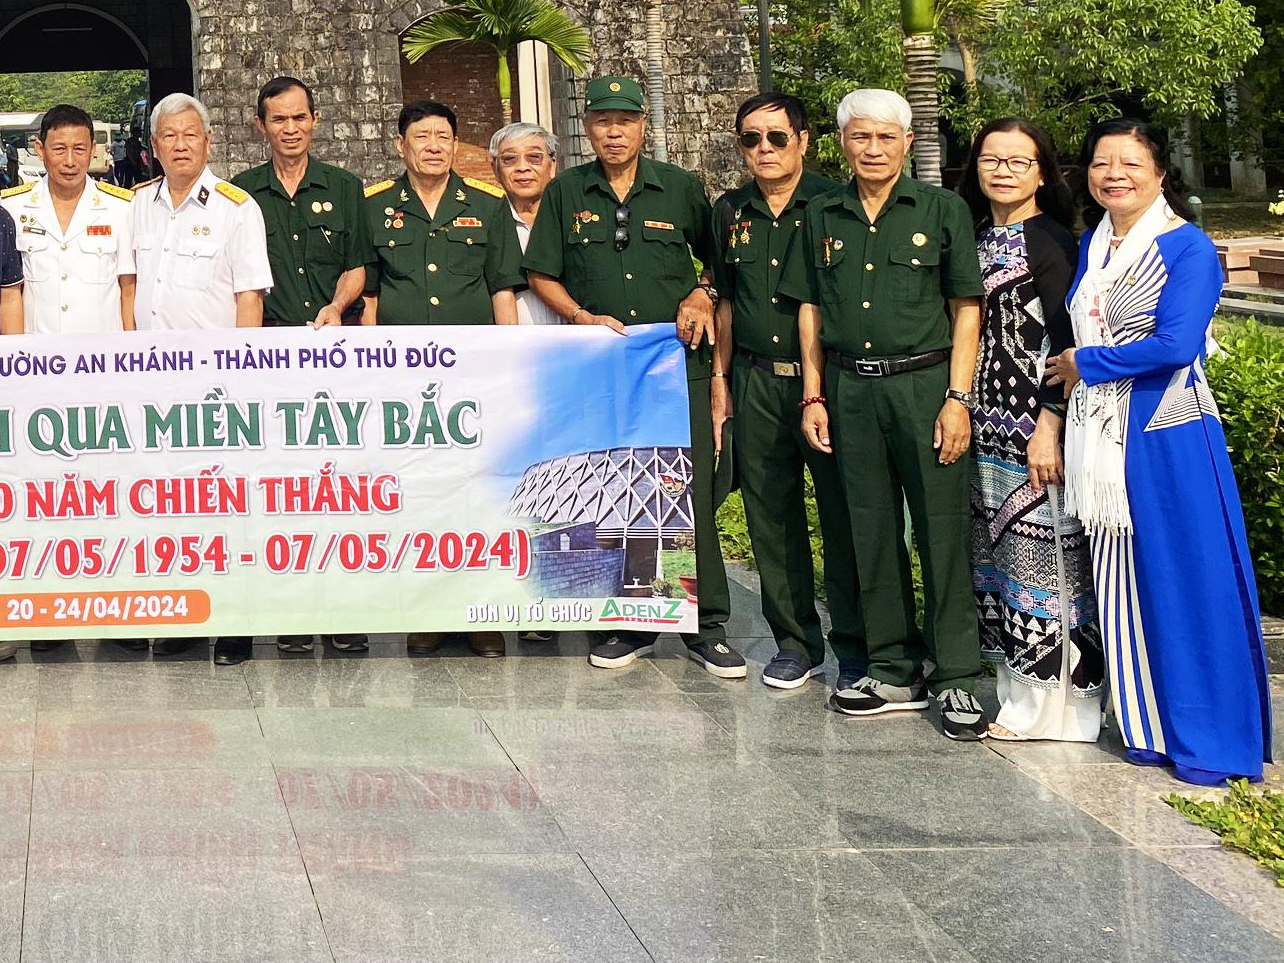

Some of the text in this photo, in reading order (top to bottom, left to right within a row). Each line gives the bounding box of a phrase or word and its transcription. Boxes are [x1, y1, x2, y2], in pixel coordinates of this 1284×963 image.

[74, 354, 105, 373] AN
[115, 346, 193, 372] KHÁNH
[214, 342, 289, 369] THÀNH
[299, 339, 346, 368] PHỐ
[354, 340, 396, 368] THỦ
[405, 341, 456, 368] ĐỨC
[28, 404, 130, 456] QUA
[144, 388, 262, 448] MIỀN
[276, 392, 367, 445] TÂY
[382, 383, 477, 445] BẮC
[27, 474, 115, 517] NĂM
[130, 466, 246, 514] CHIẾN
[260, 462, 398, 512] THẮNG
[266, 530, 528, 575] 07/05/2024)
[7, 599, 34, 620] 20
[54, 595, 189, 620] 24/04/2024
[467, 597, 592, 625] ĐƠN VỊ TỔ CHỨC
